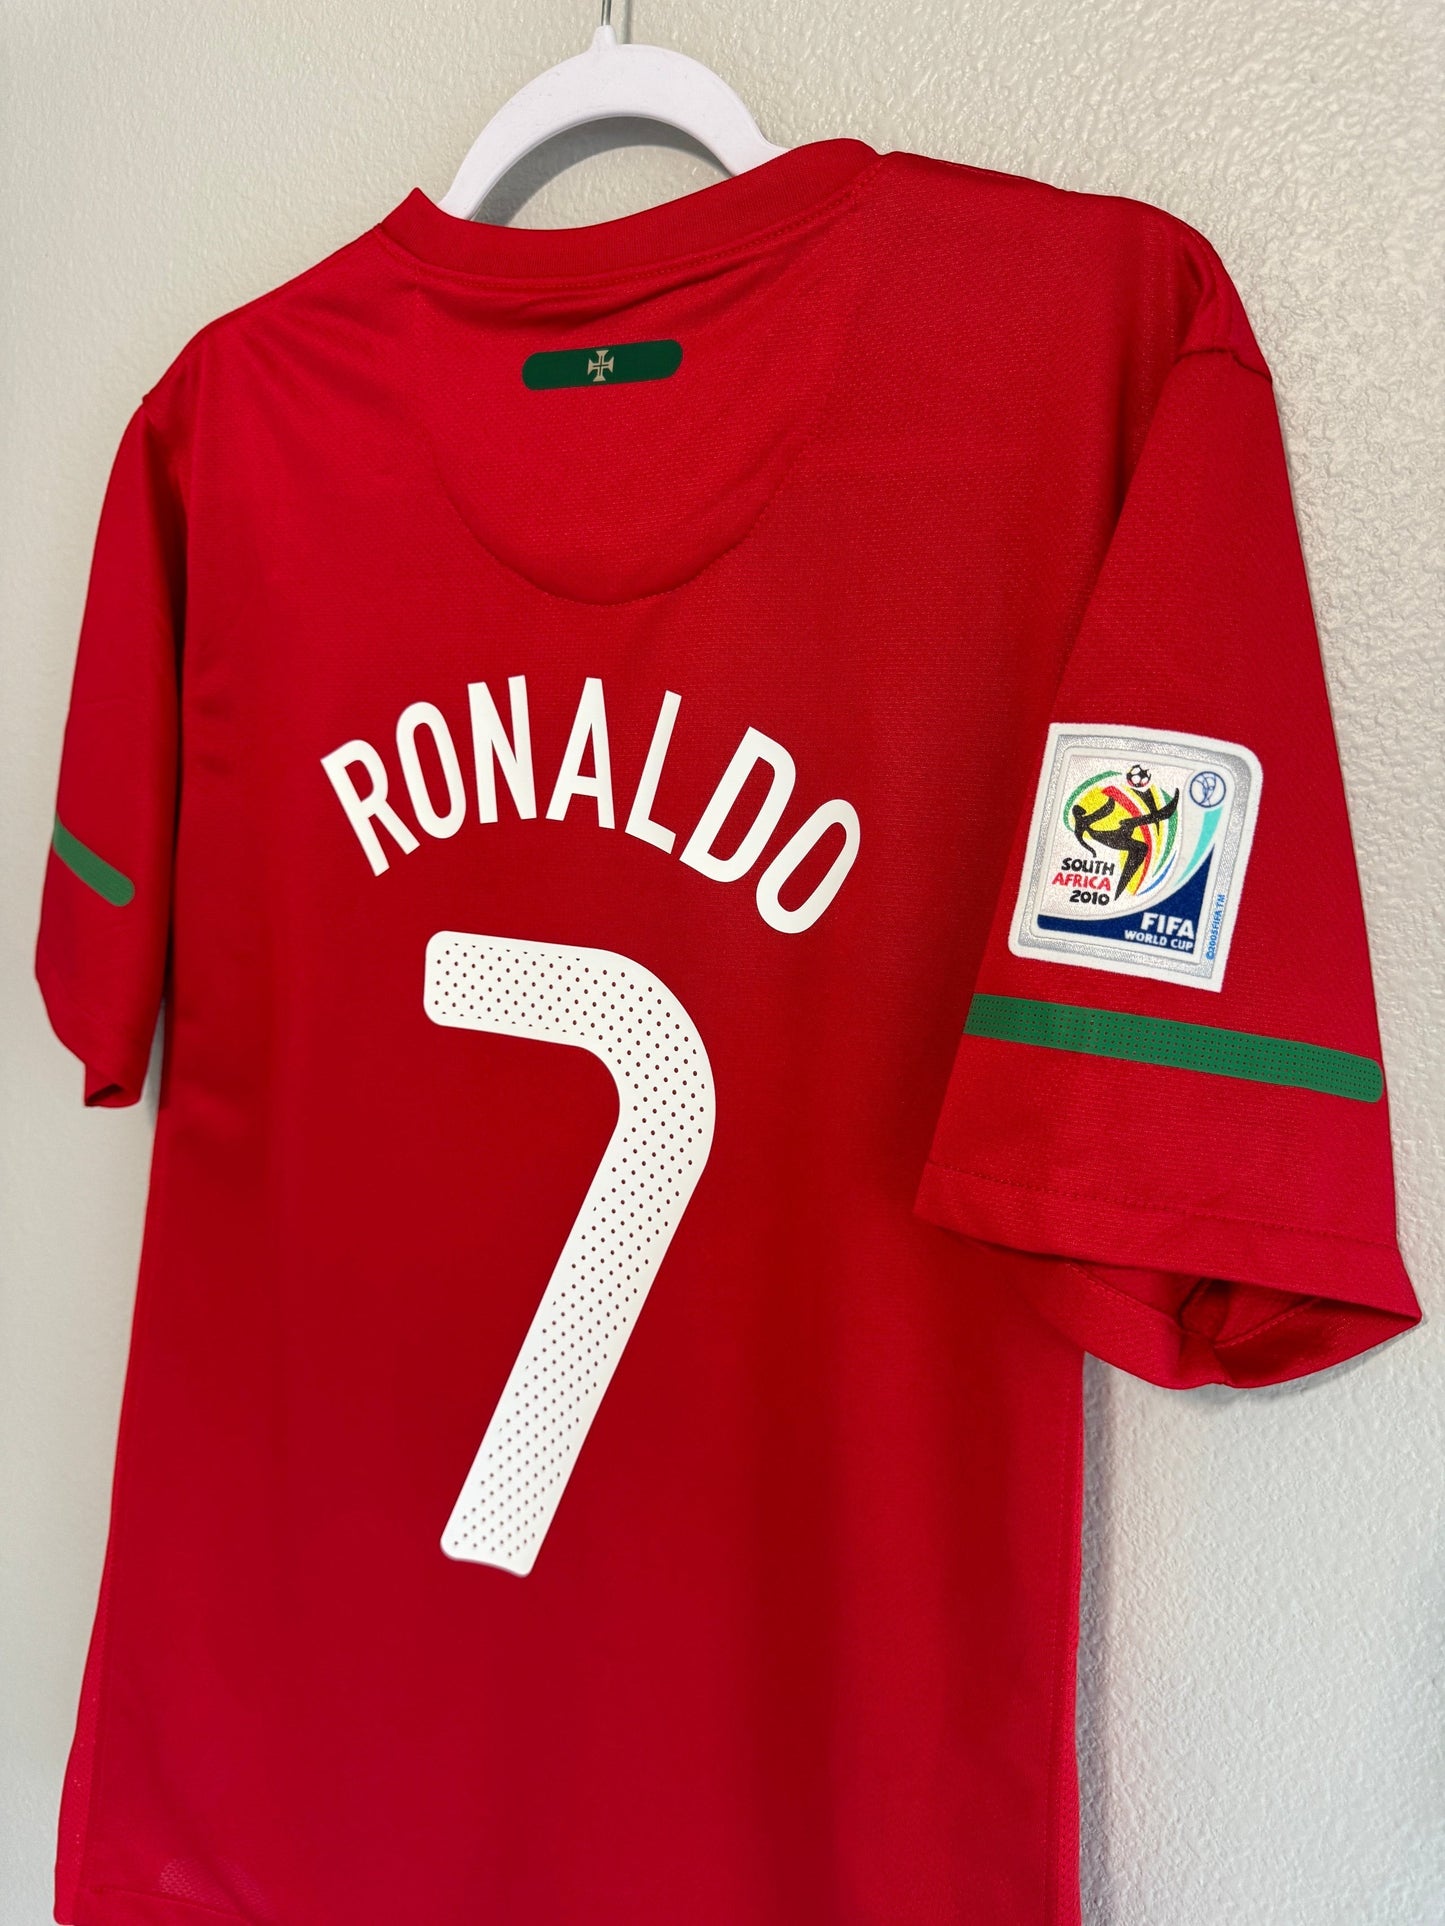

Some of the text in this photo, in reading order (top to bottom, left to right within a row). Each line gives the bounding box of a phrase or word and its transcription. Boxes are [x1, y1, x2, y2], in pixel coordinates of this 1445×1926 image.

[320, 675, 861, 934] RONALDO
[1061, 857, 1115, 876] SOUTH
[1052, 872, 1111, 891] AFRICA
[1069, 890, 1110, 905] 2010
[1140, 912, 1195, 939] FIFA
[1124, 930, 1194, 951] WORLD CUP
[424, 931, 716, 1577] 7
